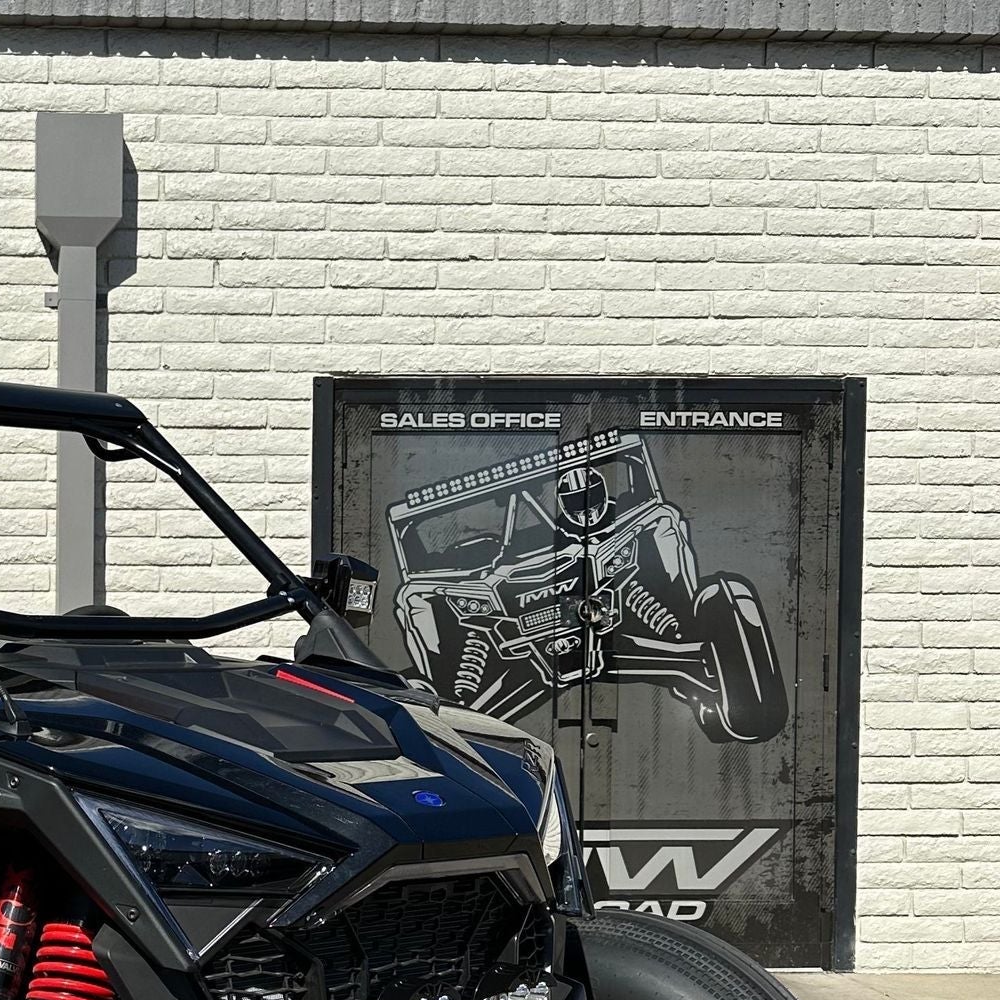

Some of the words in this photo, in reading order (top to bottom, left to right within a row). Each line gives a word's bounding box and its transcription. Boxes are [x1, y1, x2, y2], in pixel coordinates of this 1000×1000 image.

[380, 413, 466, 428] SALES
[470, 413, 561, 428] OFFICE
[639, 411, 783, 427] ENTRANCE
[515, 577, 579, 608] TMW
